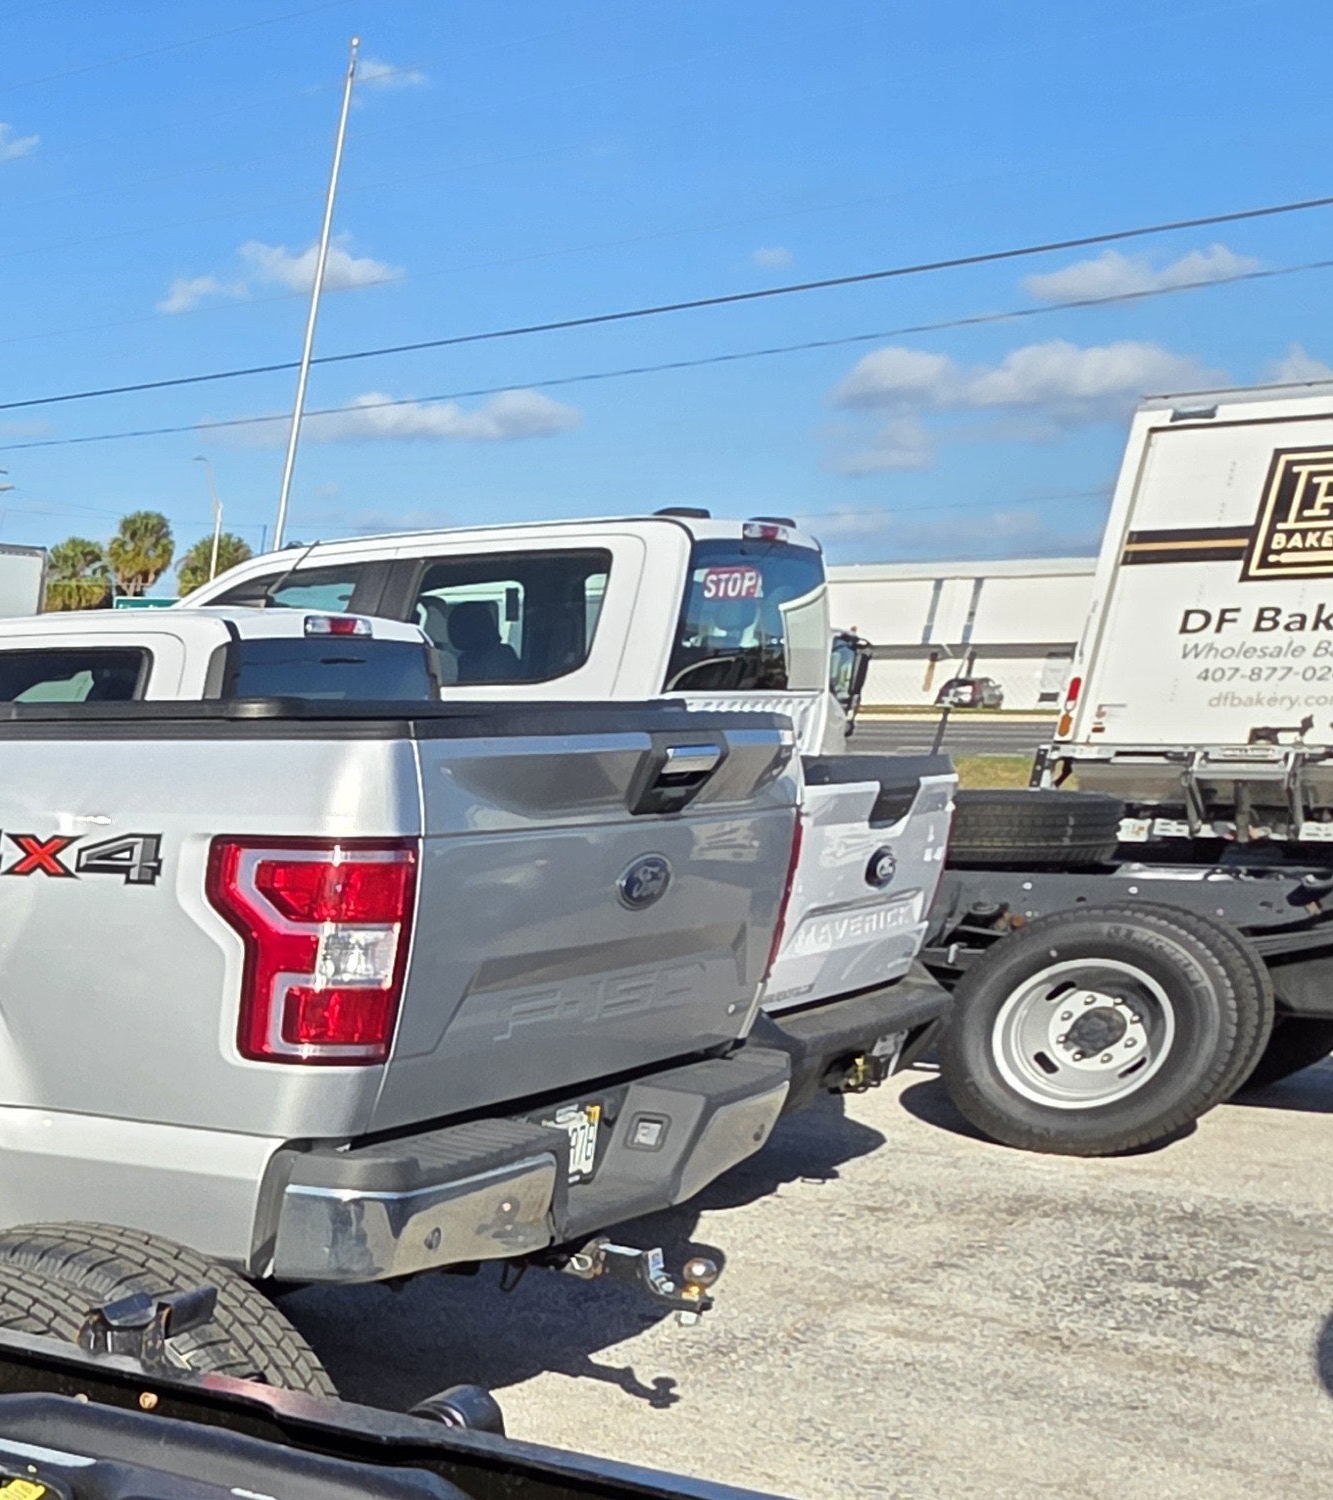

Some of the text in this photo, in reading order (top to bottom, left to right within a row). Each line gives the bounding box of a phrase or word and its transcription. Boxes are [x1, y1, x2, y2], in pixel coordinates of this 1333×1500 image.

[1178, 607, 1242, 634] DF
[1181, 639, 1307, 660] Wholesale
[1196, 665, 1333, 682] 407-877-02
[1208, 691, 1333, 711] dfbakery.co
[796, 904, 912, 948] MAVERICK
